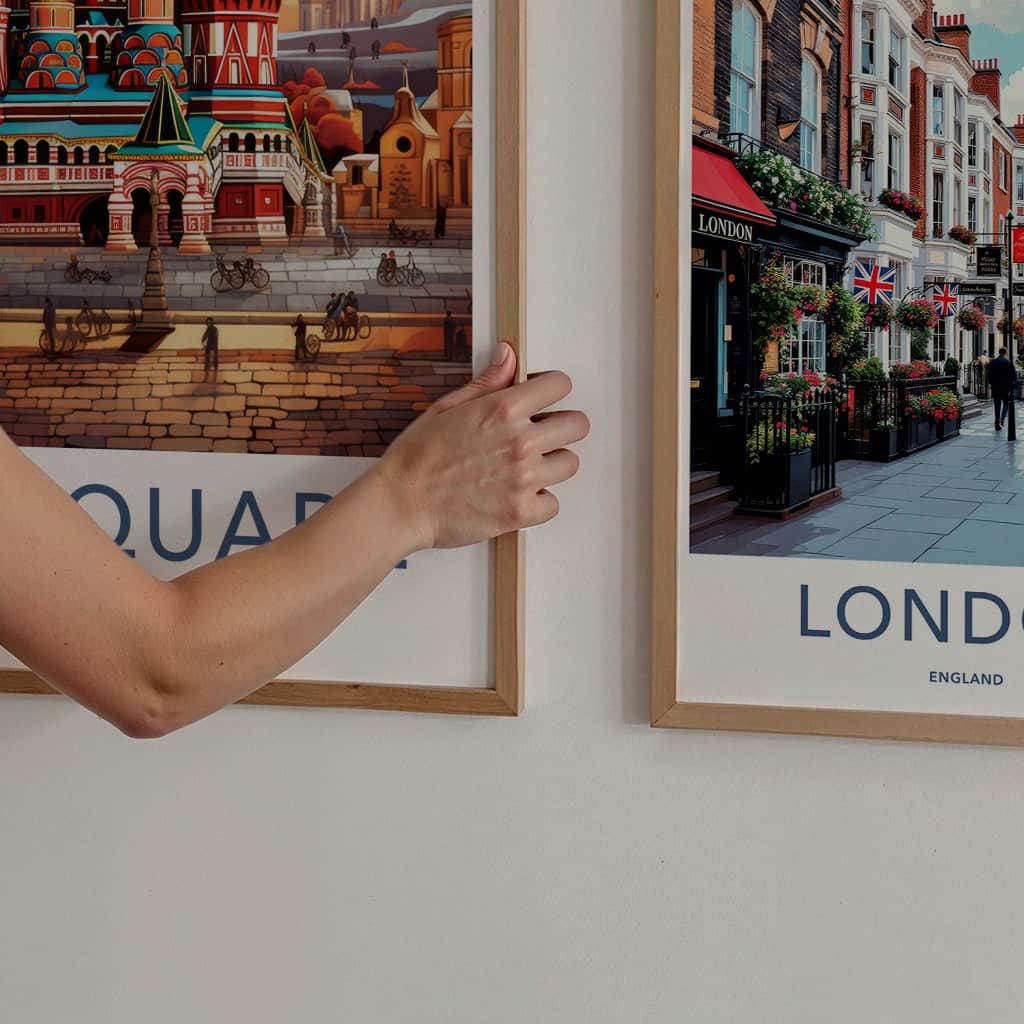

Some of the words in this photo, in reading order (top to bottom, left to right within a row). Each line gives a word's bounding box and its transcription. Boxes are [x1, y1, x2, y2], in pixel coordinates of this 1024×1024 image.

[698, 213, 753, 242] LONDON
[800, 583, 1024, 645] LOND
[929, 671, 1004, 686] ENGLAND
